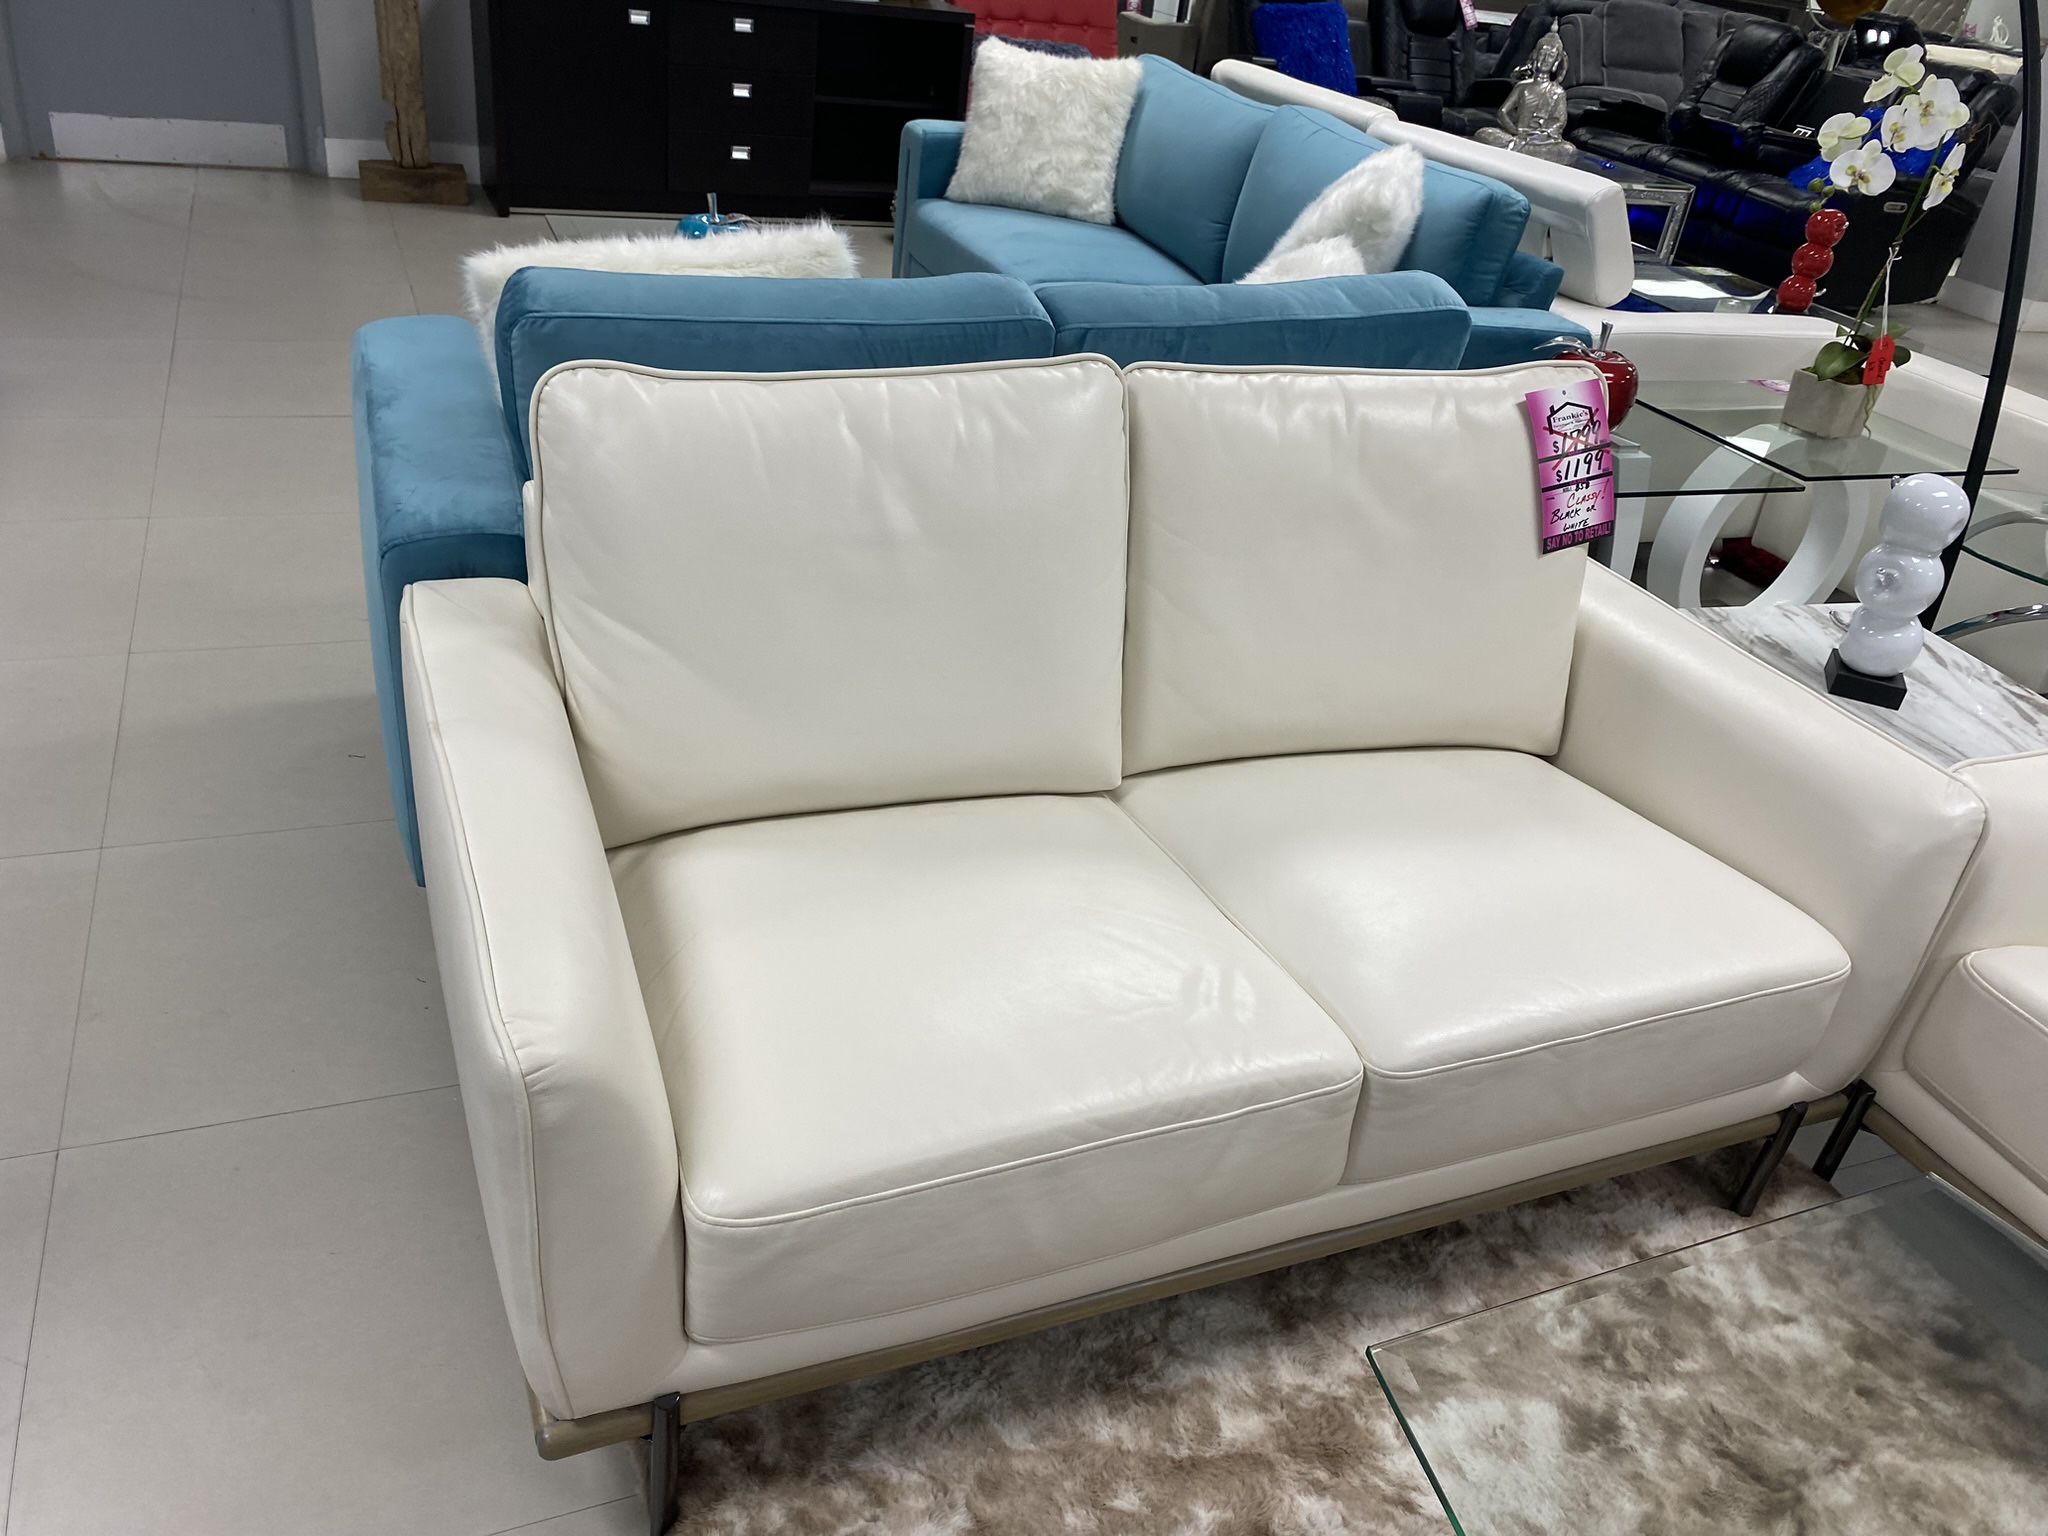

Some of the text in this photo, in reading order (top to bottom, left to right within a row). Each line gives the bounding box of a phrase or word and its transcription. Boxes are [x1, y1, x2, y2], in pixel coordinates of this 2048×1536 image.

[1552, 410, 1589, 423] Frankie's
[1556, 449, 1604, 482] $1199
[1547, 522, 1612, 550] SAY NO TO RETAIL!
